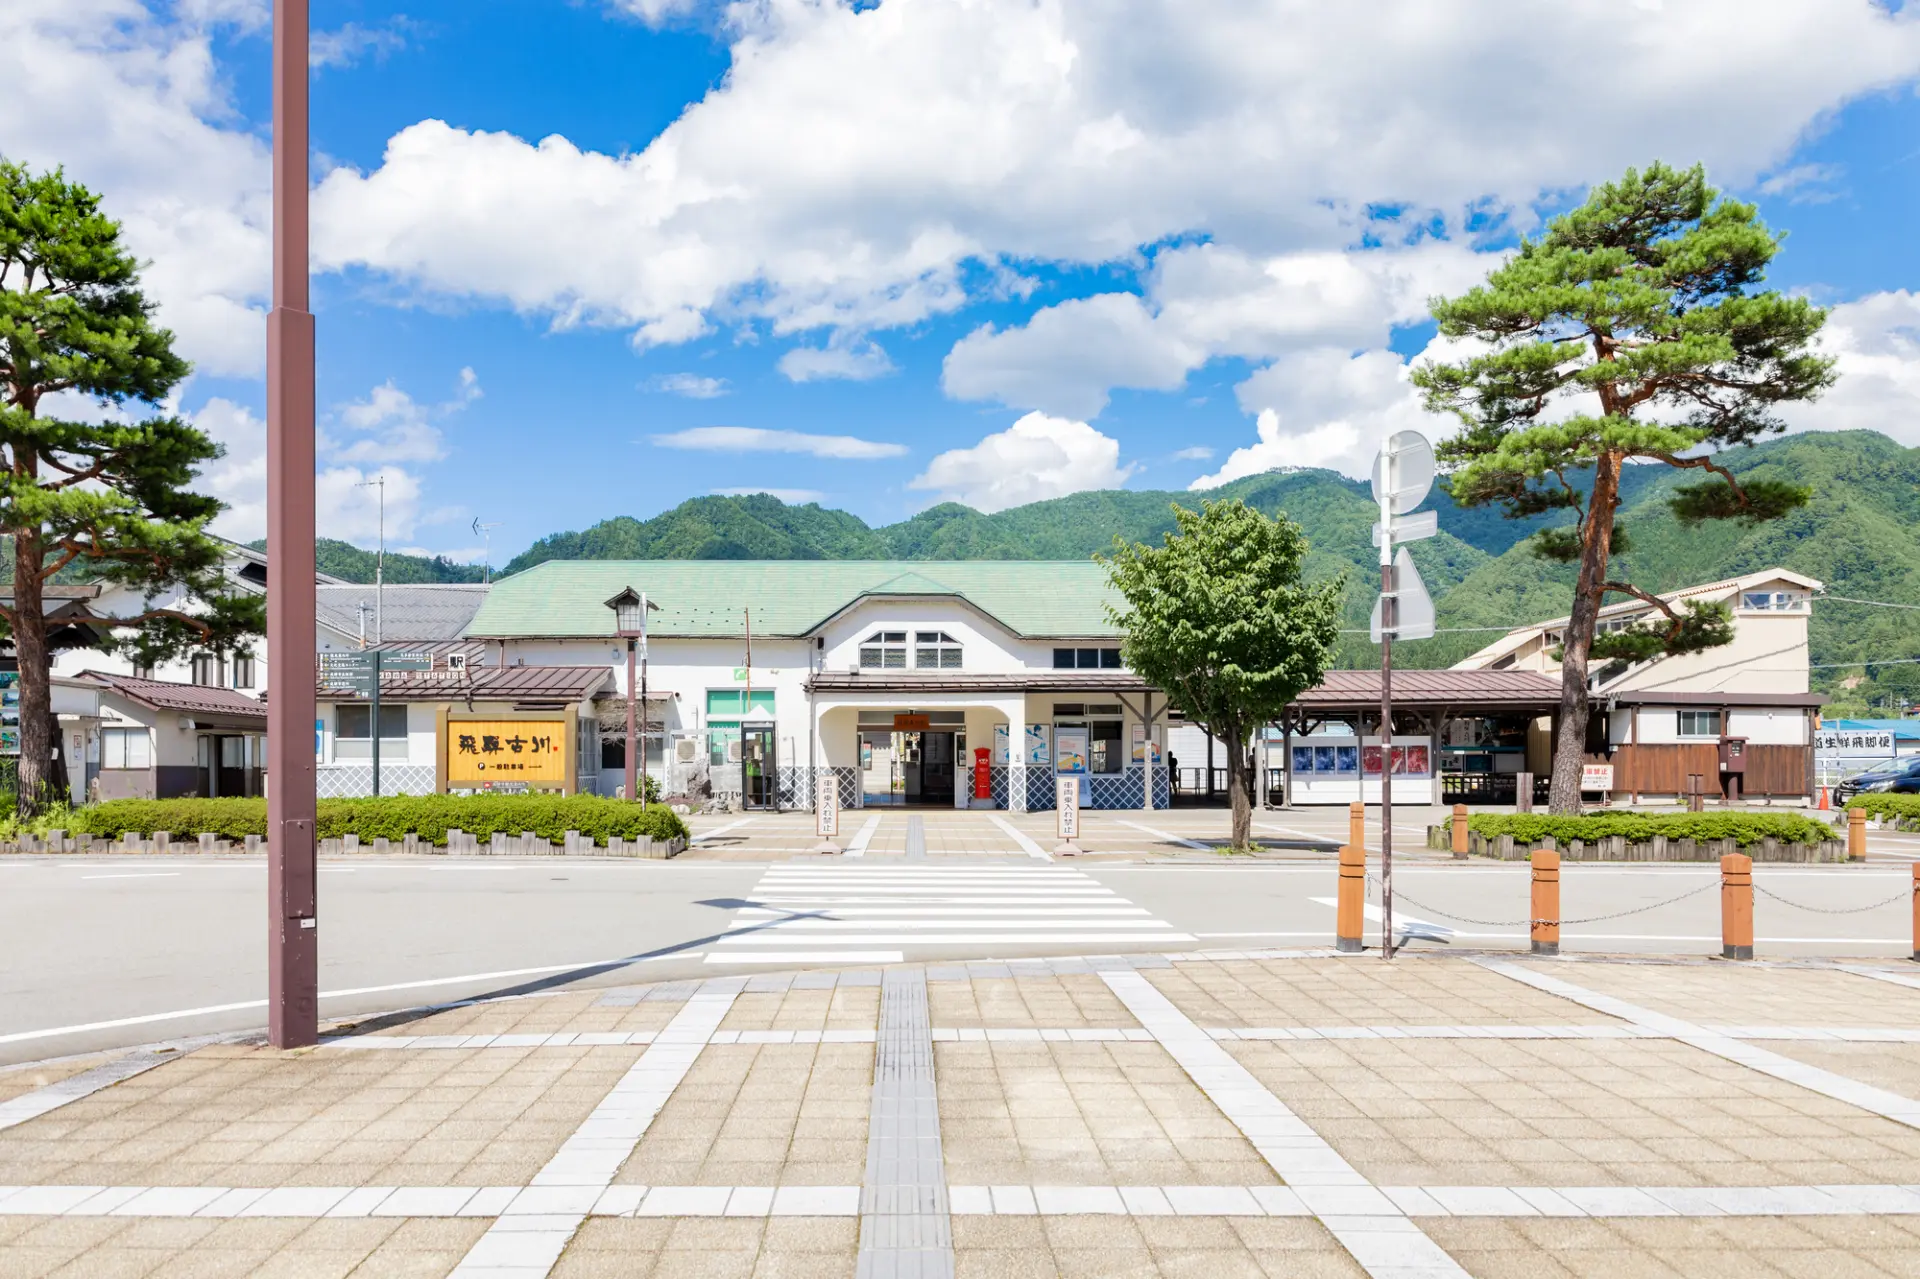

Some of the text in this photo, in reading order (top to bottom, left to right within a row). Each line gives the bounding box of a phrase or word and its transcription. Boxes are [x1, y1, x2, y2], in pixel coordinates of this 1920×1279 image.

[449, 656, 464, 669] 駅
[416, 672, 466, 680] STATION
[459, 734, 551, 755] 飛騨古川
[823, 779, 833, 832] 車両乗入れ禁止
[1063, 781, 1073, 834] 車両乗入れ禁止
